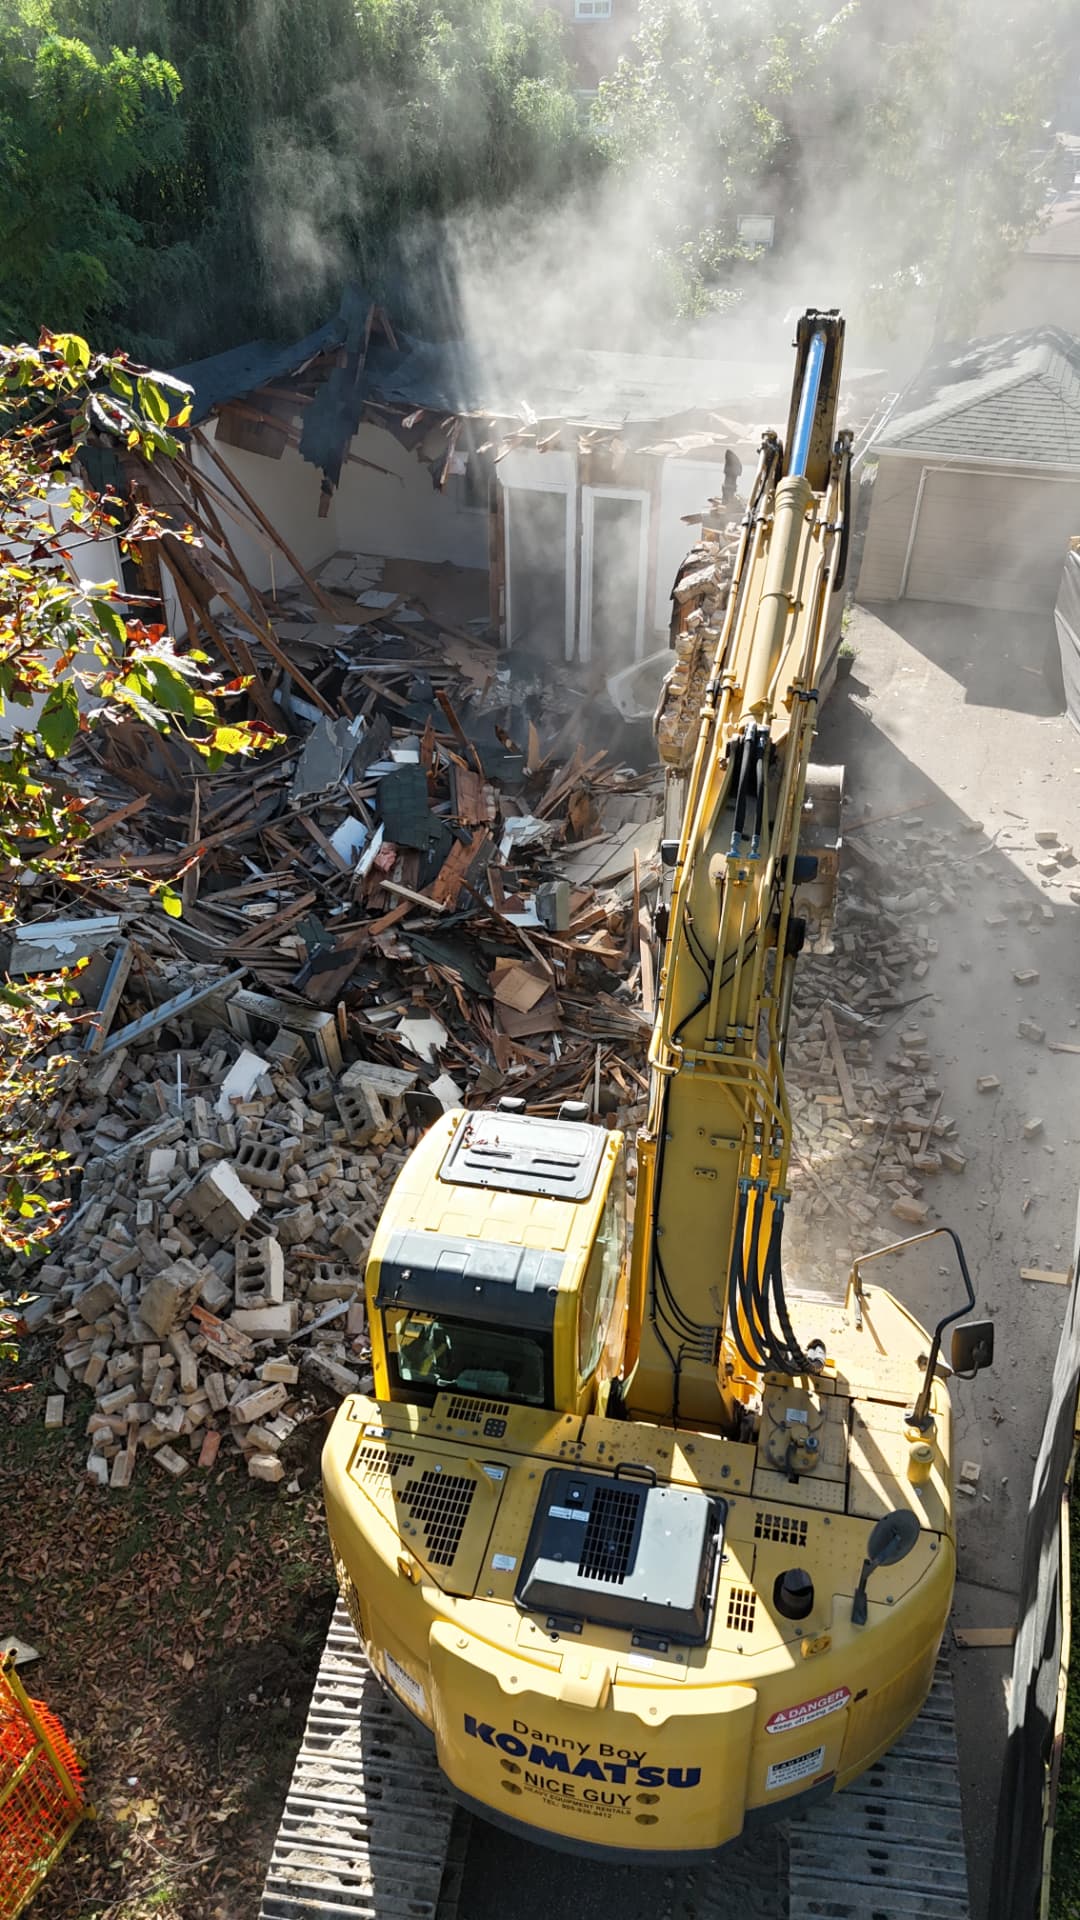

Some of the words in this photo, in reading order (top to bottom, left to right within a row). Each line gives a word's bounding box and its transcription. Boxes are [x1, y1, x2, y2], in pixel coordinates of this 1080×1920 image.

[773, 1722, 793, 1731] Keep
[794, 1717, 805, 1725] off
[807, 1709, 826, 1720] swing
[789, 1690, 844, 1719] DANGER
[464, 1713, 702, 1789] KOMATSU
[513, 1719, 591, 1756] Danny
[600, 1744, 647, 1765] Boy
[524, 1771, 576, 1798] NICE
[583, 1789, 632, 1807] GUY
[549, 1794, 593, 1809] EQUIPMENT
[596, 1805, 632, 1815] RENTALS
